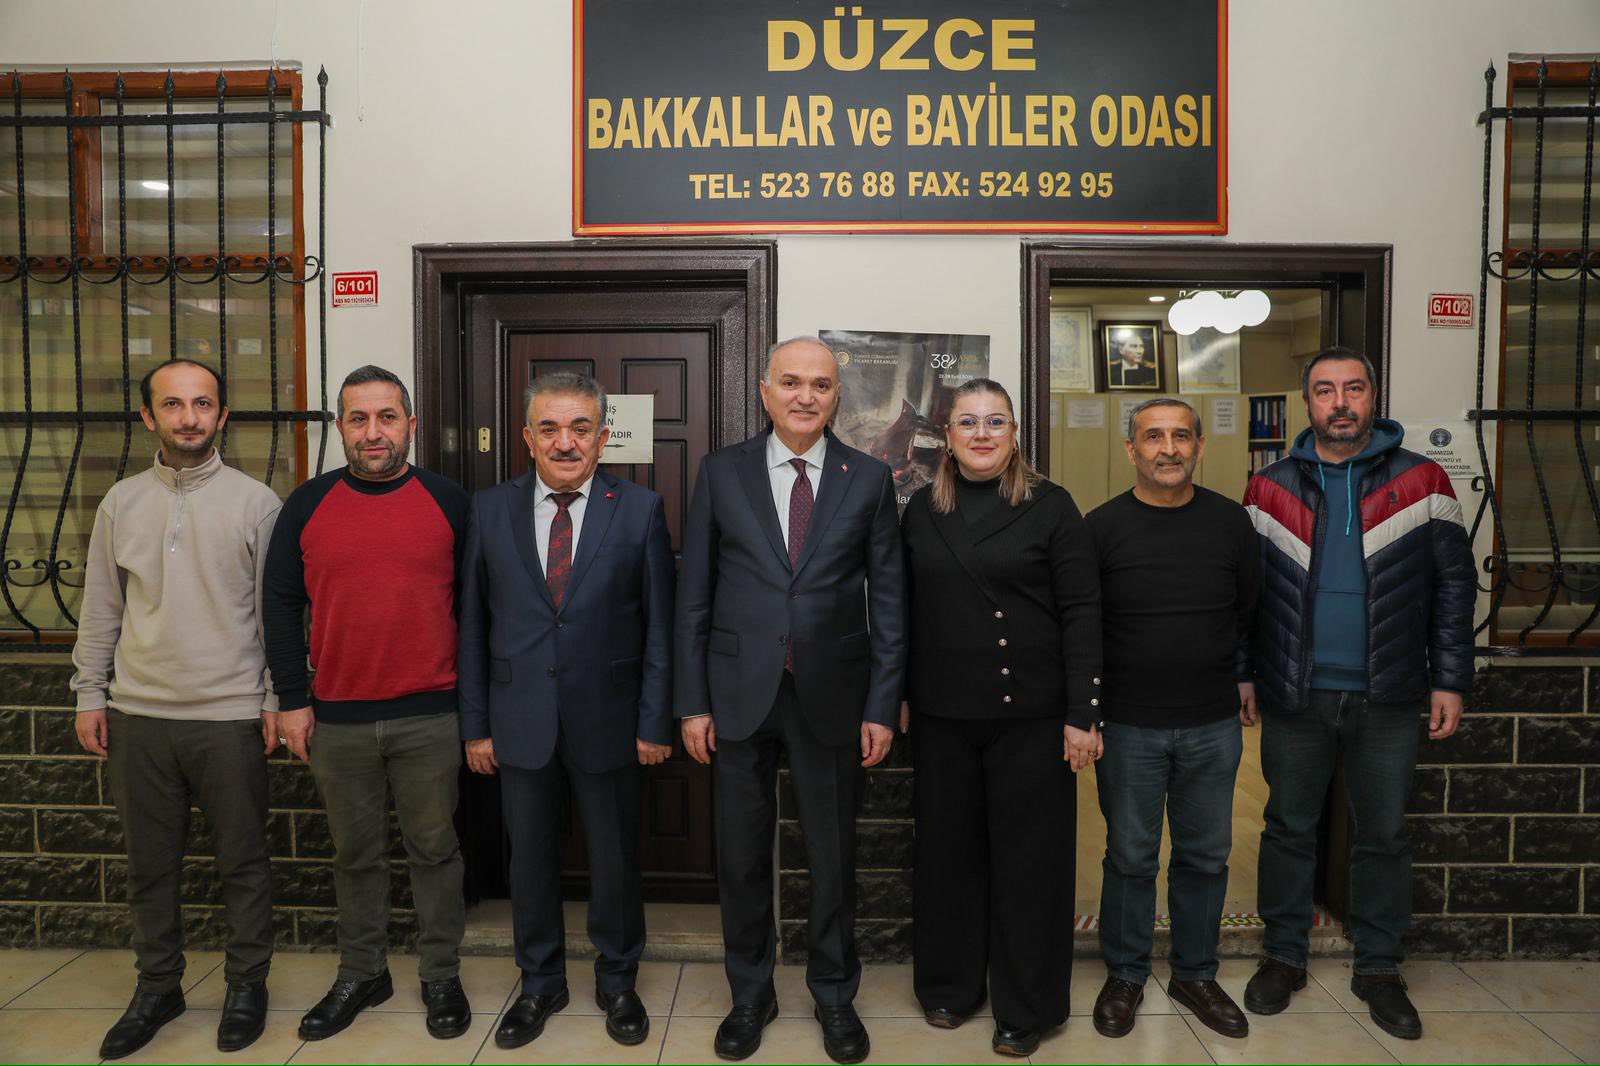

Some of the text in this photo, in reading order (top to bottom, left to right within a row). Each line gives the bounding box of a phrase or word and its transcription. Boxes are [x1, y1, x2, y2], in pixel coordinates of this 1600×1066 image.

[767, 6, 1037, 72] DÜZCE
[588, 82, 1212, 149] BAKKALLAR ve BAYİLER ODASI
[689, 171, 1114, 199] TEL: 523 76 88 FAX: 524 92 95
[337, 280, 372, 292] 6/101
[1433, 300, 1469, 314] 6/102
